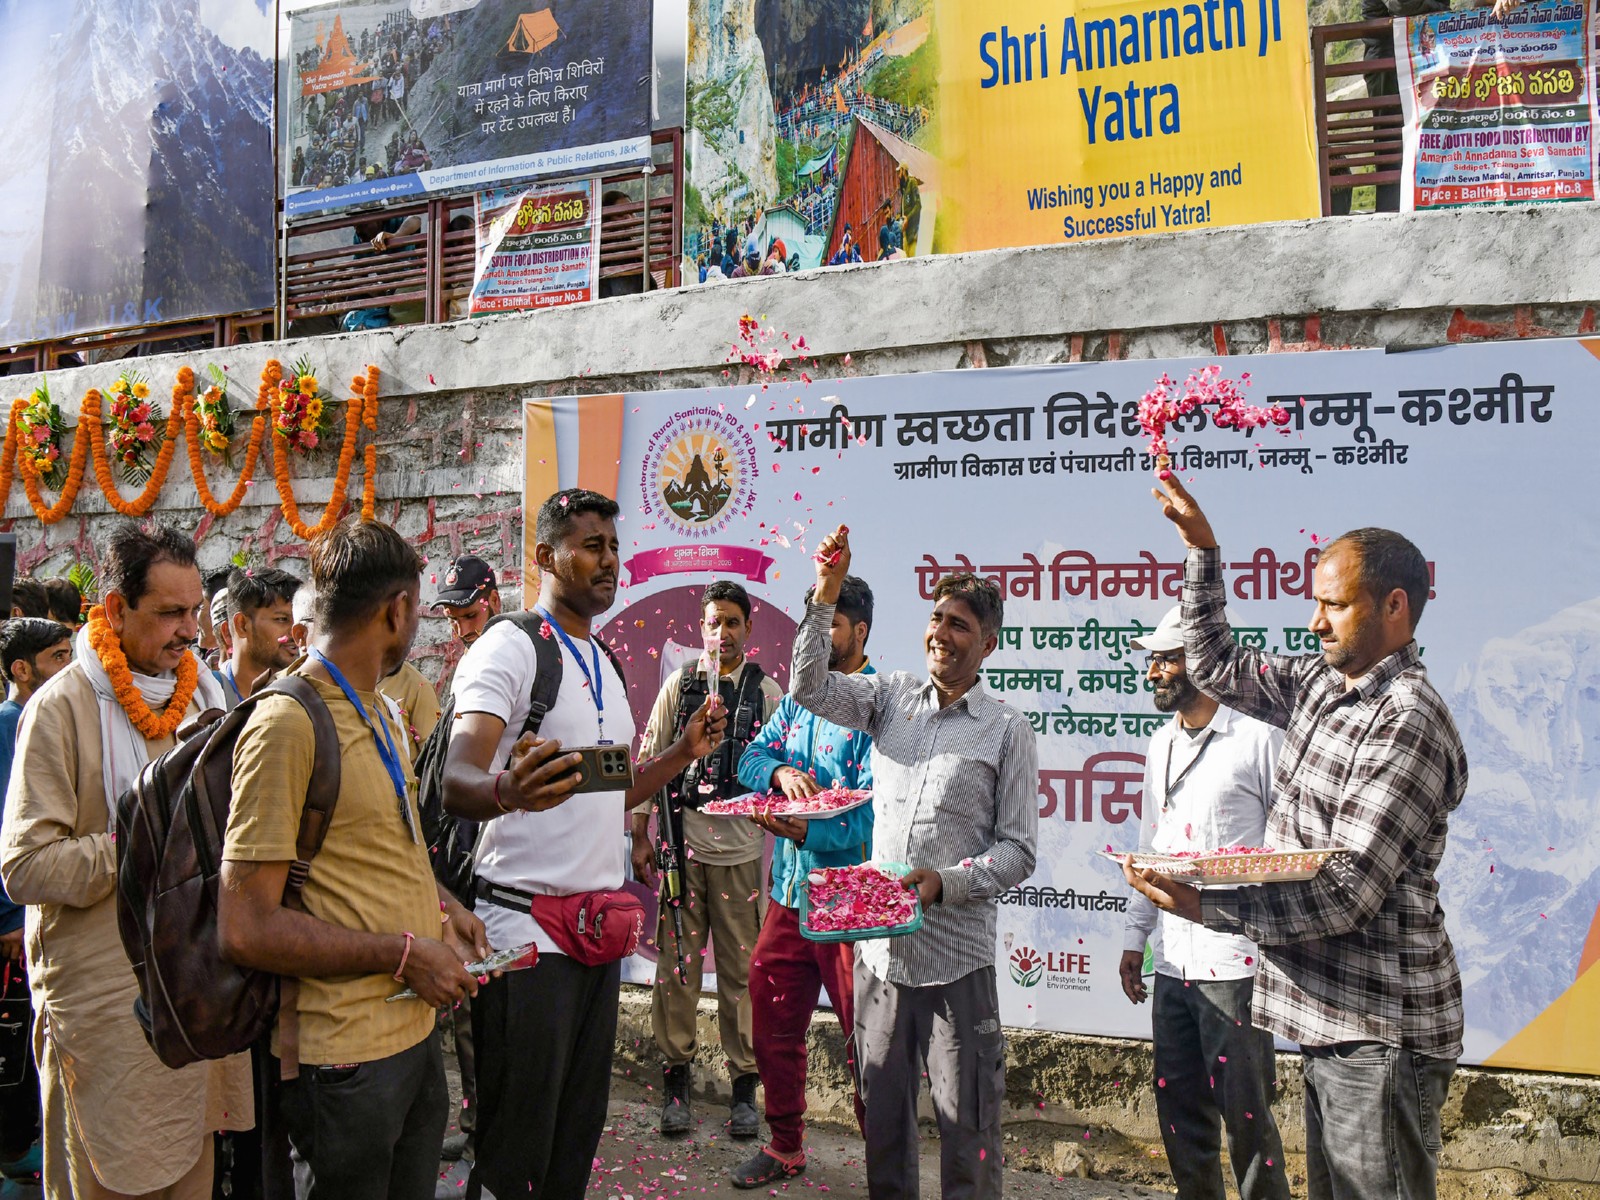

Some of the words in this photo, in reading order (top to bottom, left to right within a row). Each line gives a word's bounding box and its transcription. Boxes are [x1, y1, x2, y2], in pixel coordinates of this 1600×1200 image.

[979, 24, 1048, 89] Shri
[1060, 0, 1246, 75] Amarnath
[457, 83, 481, 98] यात्रा
[485, 74, 507, 94] मार्ग
[509, 75, 524, 89] पर
[527, 66, 564, 87] विभिन्न
[566, 57, 605, 81] शिविरों
[1474, 67, 1526, 101] భోజన
[1529, 67, 1575, 96] వసతి
[475, 98, 485, 115] में
[487, 95, 509, 114] रहने
[513, 92, 524, 109] के
[528, 89, 550, 107] लिए
[554, 84, 589, 102] किराए
[481, 120, 496, 135] पर
[499, 112, 515, 133] टेंट
[517, 111, 558, 130] उपलब्ध
[1078, 80, 1180, 145] Yatra
[1565, 109, 1576, 118] 8
[1420, 133, 1441, 149] FREE
[1442, 130, 1473, 150] SOUTH
[1474, 130, 1500, 147] FOOD
[1503, 126, 1573, 146] DISTRIBUTION
[1575, 125, 1589, 142] BY
[429, 169, 477, 185] Department
[478, 166, 487, 176] of
[488, 160, 535, 176] Information
[537, 158, 544, 168] &
[547, 153, 574, 167] Public
[575, 148, 618, 163] Relations,
[619, 143, 638, 156] J&K
[1420, 150, 1462, 163] Amarnath
[1465, 148, 1517, 161] Annadanna
[1520, 147, 1545, 158] Seva
[1547, 145, 1586, 157] Samathi
[1027, 182, 1094, 211] Wishing
[1099, 180, 1130, 207] you
[1135, 178, 1145, 198] a
[1150, 172, 1205, 198] Happy
[1210, 163, 1242, 188] and
[1420, 174, 1456, 185] Amarnath
[1458, 174, 1480, 183] Sewa
[1517, 171, 1556, 180] Amritsar,
[1557, 169, 1585, 178] Punjab
[1421, 187, 1452, 202] Place
[1461, 186, 1507, 200] Balthal,
[1510, 185, 1551, 199] Langar
[1554, 182, 1582, 195] No.8
[517, 200, 552, 229] భోజన
[554, 199, 584, 222] వసతి
[1064, 206, 1157, 239] Successful
[1160, 200, 1211, 227] Yatra!
[491, 254, 513, 268] SOUTH
[514, 253, 532, 267] FOOD
[532, 249, 579, 265] DISTRIBUTION
[580, 246, 590, 259] BY
[506, 267, 542, 277] Annadanna
[544, 265, 559, 274] Seva
[561, 261, 587, 272] Samathi
[475, 300, 496, 310] Place
[535, 293, 563, 305] Langar
[564, 290, 583, 302] No.8
[674, 406, 724, 422] Sanitation,
[725, 413, 738, 427] RD
[652, 416, 674, 441] Rural
[736, 424, 744, 434] &
[741, 432, 753, 447] PR
[766, 404, 887, 454] ग्रामीण
[894, 405, 1035, 448] स्वच्छता
[648, 438, 657, 452] of
[894, 454, 957, 481] ग्रामीण
[961, 453, 1024, 477] विकास
[1028, 450, 1056, 475] एवं
[1060, 447, 1136, 474] पंचायती
[1181, 445, 1253, 472] विभाग,
[1258, 446, 1312, 474] जम्मू
[1333, 439, 1408, 466] कश्मीर
[640, 453, 653, 515] Directorate
[744, 489, 757, 512] J&K
[1030, 626, 1075, 650] एक
[986, 668, 1064, 693] चम्मच
[1052, 704, 1118, 737] लेकर
[1077, 890, 1129, 913] पार्टनर
[1047, 952, 1091, 974] LiFE
[1047, 974, 1076, 985] Lifestyle
[1077, 976, 1088, 985] for
[1047, 982, 1091, 992] Environment
